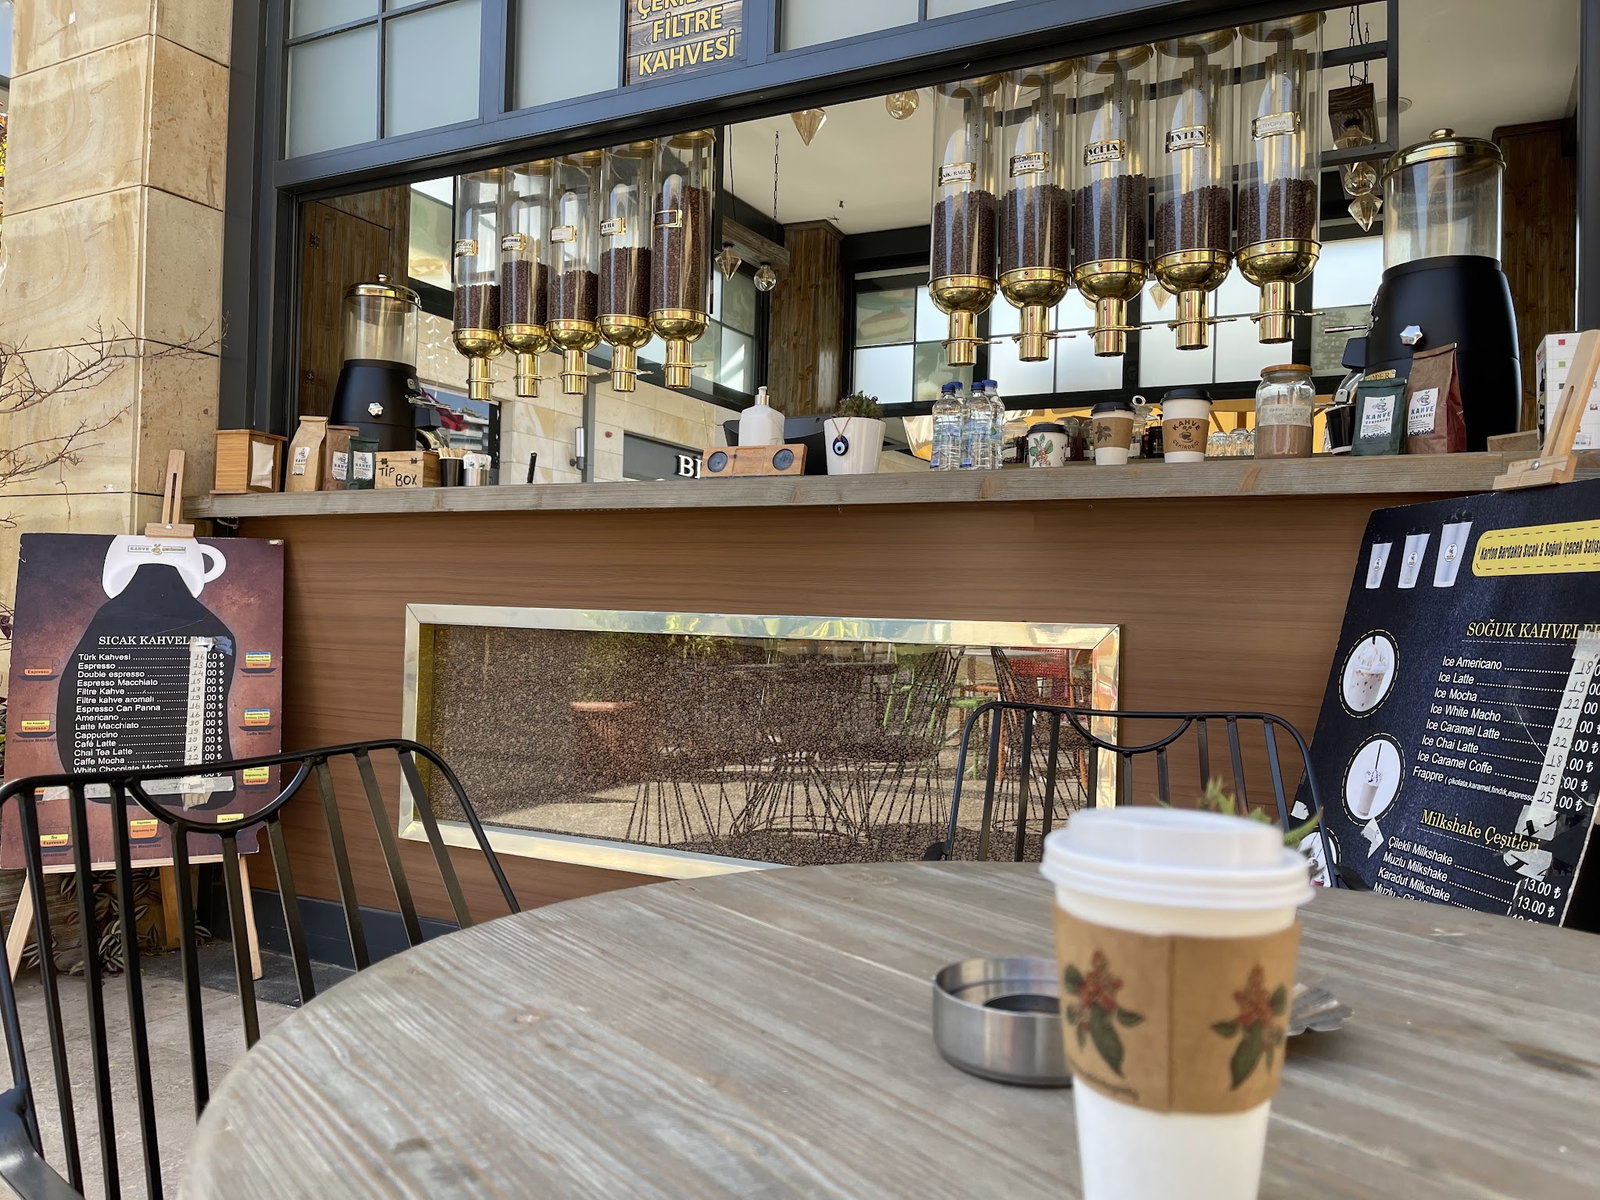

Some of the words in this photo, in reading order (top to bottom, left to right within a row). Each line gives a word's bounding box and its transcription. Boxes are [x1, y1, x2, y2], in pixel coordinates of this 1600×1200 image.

[652, 6, 724, 43] FİLTRE
[639, 29, 736, 76] KAHVESİ
[1365, 411, 1392, 420] KAHVE
[1411, 406, 1434, 415] KAHVE
[1172, 419, 1201, 431] KAHVE
[395, 473, 417, 487] BOX
[1466, 618, 1517, 638] SOĞUK
[98, 636, 137, 645] SICAK
[78, 662, 116, 670] Espresso
[1442, 656, 1455, 667] Ice
[1456, 656, 1502, 670] Americano
[1575, 661, 1593, 675] 18
[1438, 672, 1450, 683] Ice
[1453, 673, 1475, 685] Latte
[1434, 687, 1447, 699] Ice
[1449, 688, 1478, 702] Mocha
[1563, 698, 1580, 710] 22
[76, 705, 113, 713] Espresso
[1430, 703, 1443, 715] Ice
[1445, 704, 1469, 718] White
[1470, 708, 1501, 722] Macho
[1557, 717, 1572, 729] 22
[75, 732, 118, 740] Cappucino
[1425, 719, 1438, 730] Ice
[1440, 720, 1475, 736] Caramel
[1477, 726, 1500, 740] Latte
[1553, 736, 1568, 748] 22
[74, 749, 93, 757] Chai
[1421, 734, 1434, 746] Ice
[1436, 736, 1456, 750] Chai
[1456, 740, 1479, 755] Latte
[1546, 754, 1563, 768] 18
[73, 758, 96, 766] Caffe
[1417, 750, 1430, 762] Ice
[1431, 752, 1467, 770] Caramel
[1468, 760, 1493, 774] Coffe
[1412, 766, 1444, 784] Frappre
[1420, 809, 1481, 839] Milkshake
[1388, 836, 1412, 851] Çilekli
[1412, 843, 1453, 866] Milkshake
[1524, 877, 1552, 896] 13.00
[1378, 866, 1408, 887] Karadut
[1409, 878, 1450, 902] Milkshake
[1383, 851, 1406, 868] Muzlu
[1407, 858, 1448, 882] Milkshake
[1518, 895, 1545, 915] 13.00
